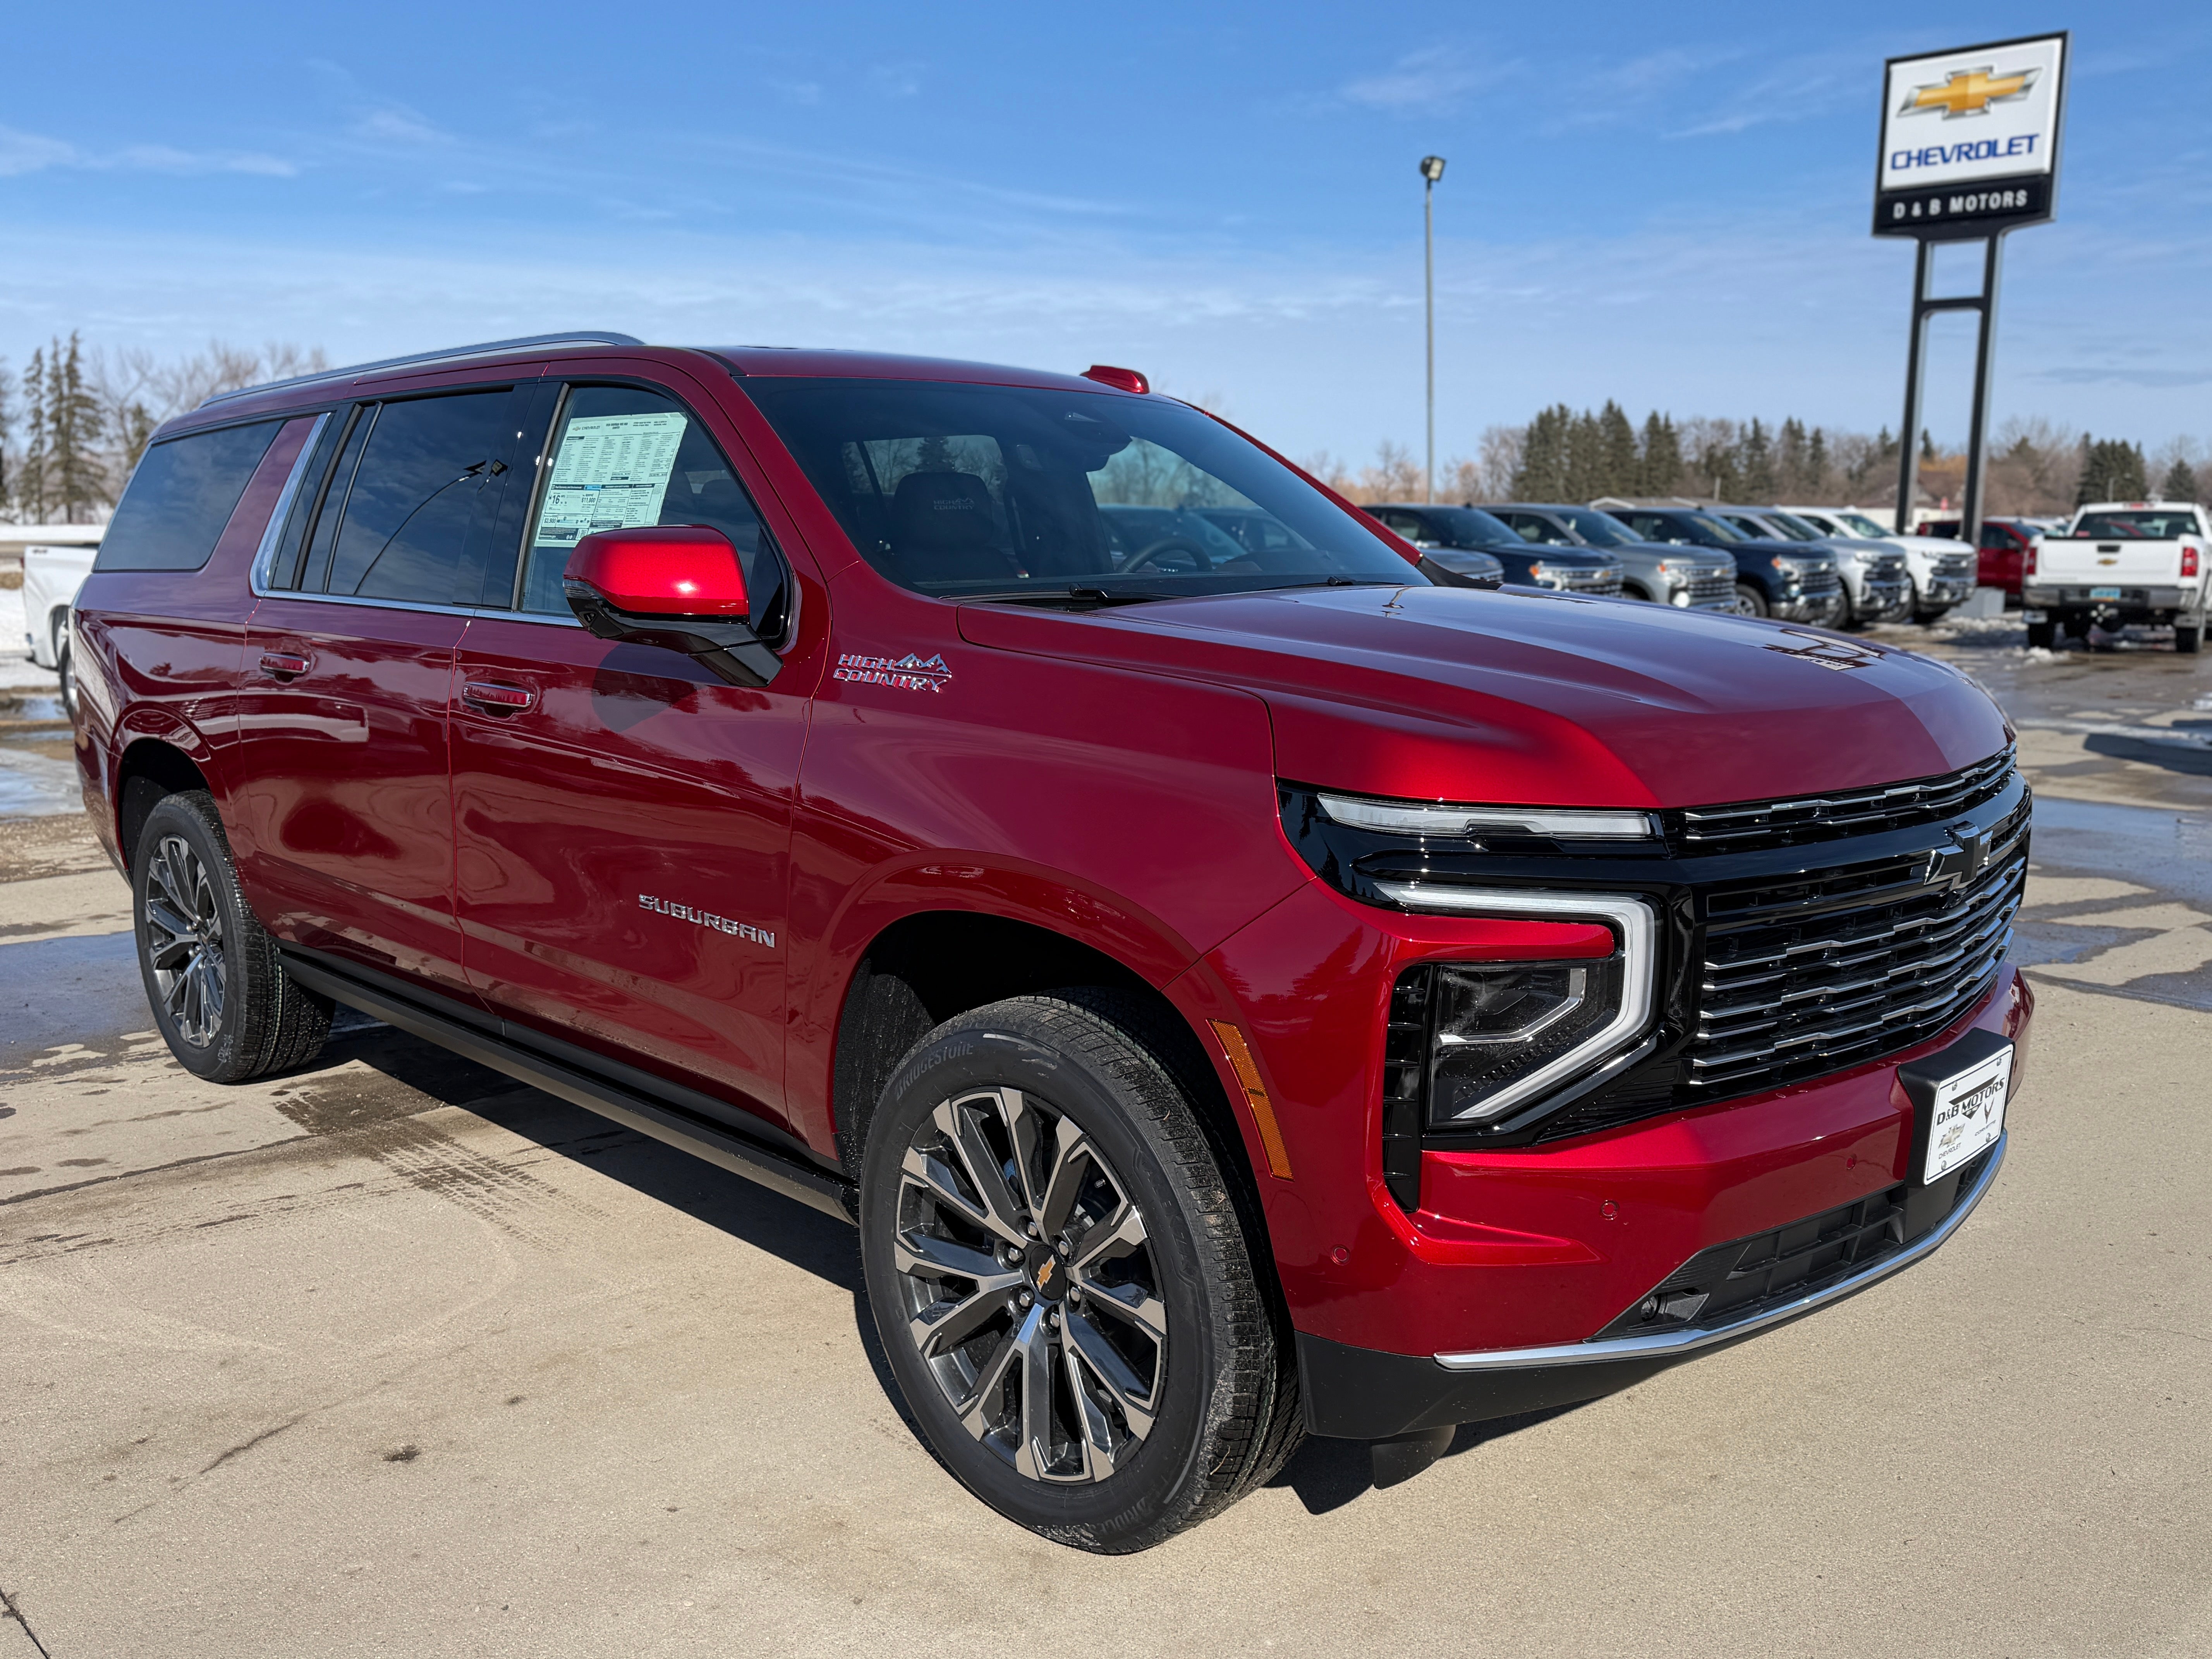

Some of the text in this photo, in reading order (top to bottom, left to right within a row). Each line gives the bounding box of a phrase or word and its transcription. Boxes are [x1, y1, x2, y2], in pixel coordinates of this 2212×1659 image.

[1891, 134, 2040, 170] CHEVROLET
[1893, 190, 2028, 219] D & B MOTORS
[553, 495, 560, 504] 16
[838, 654, 896, 670] HIGH
[833, 668, 947, 692] COUNTRY
[639, 894, 775, 948] SUBURBAN
[895, 1042, 974, 1101] BRIDGESTONE
[1936, 1077, 2005, 1126] D&B MOTORS
